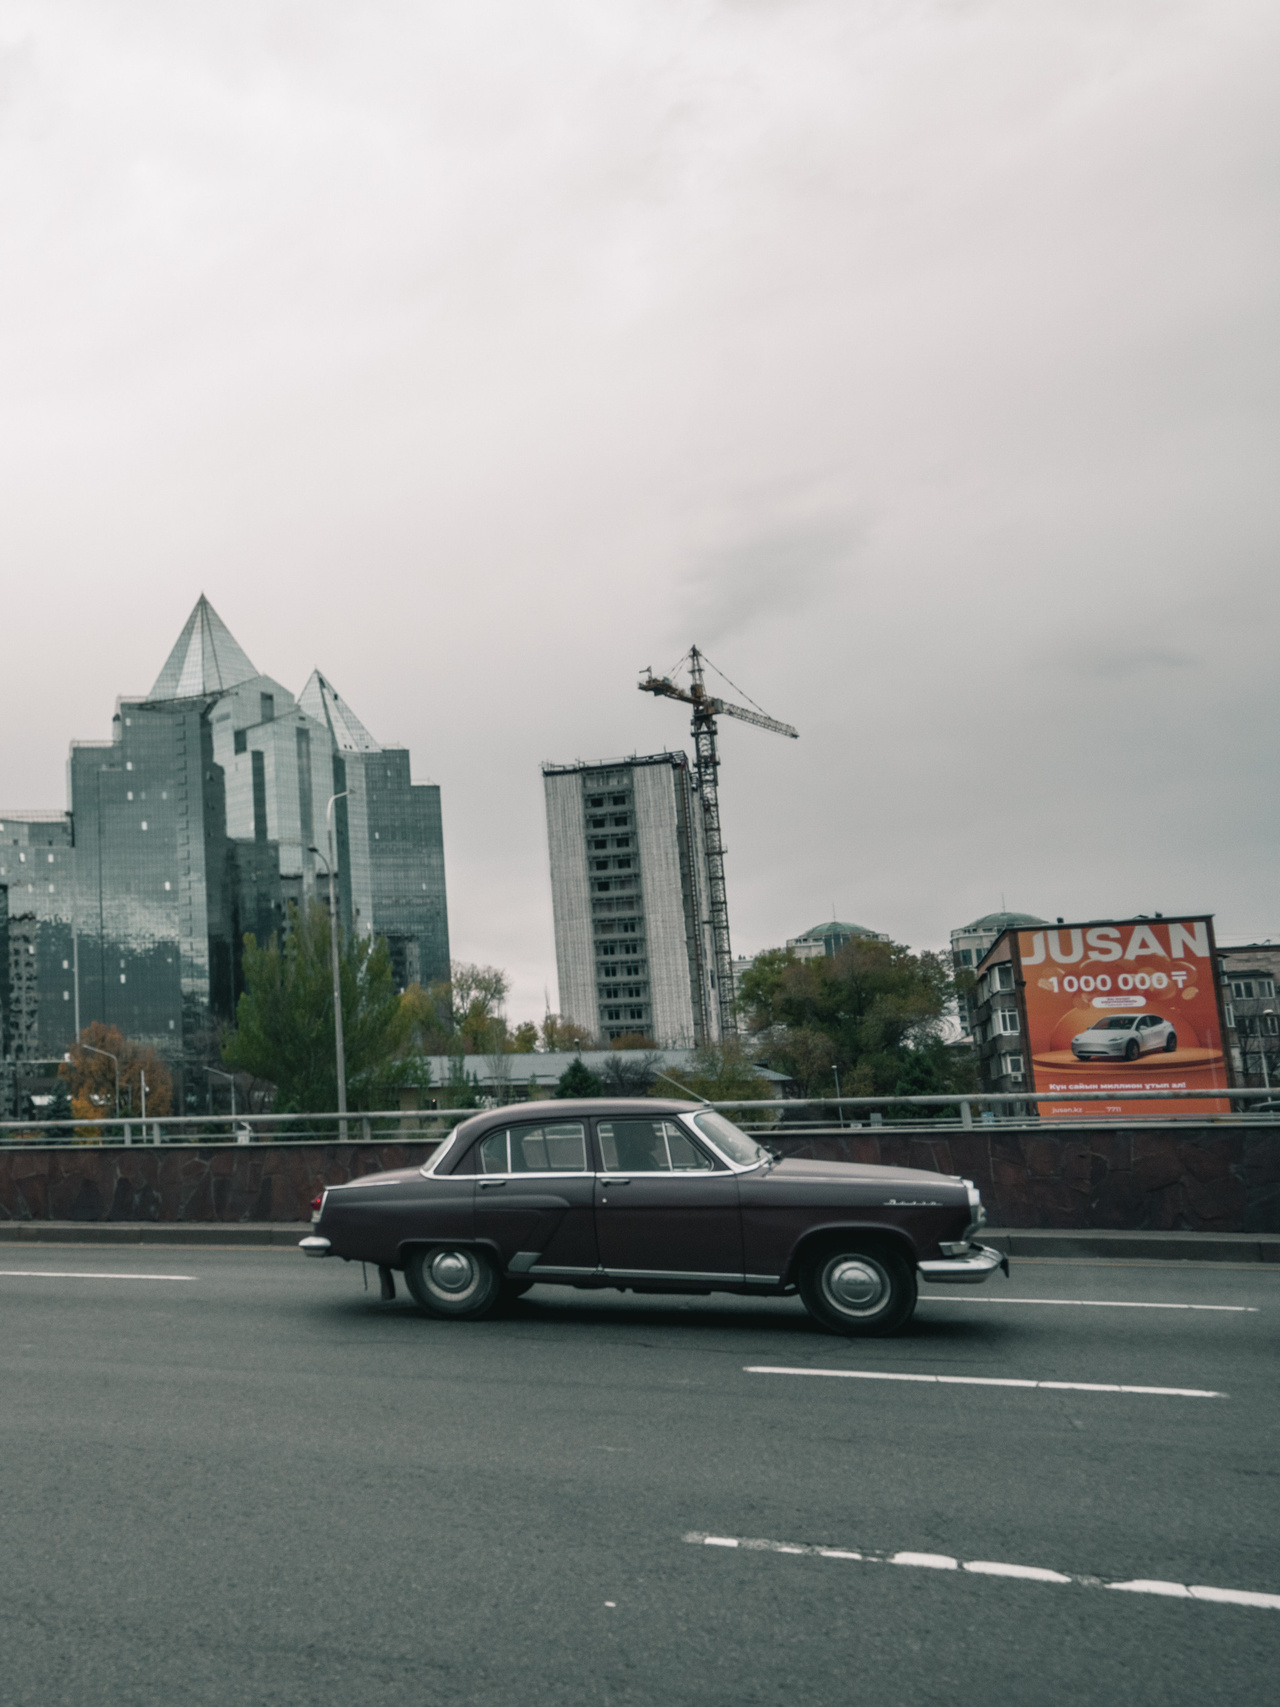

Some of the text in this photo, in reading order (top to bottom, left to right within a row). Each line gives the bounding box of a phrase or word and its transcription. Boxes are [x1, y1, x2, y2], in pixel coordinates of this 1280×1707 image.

[1020, 922, 1210, 966] JUSAN
[1049, 1083, 1067, 1092] Күн
[1068, 1082, 1098, 1090] сайын
[1052, 1106, 1083, 1115] jusan.kz
